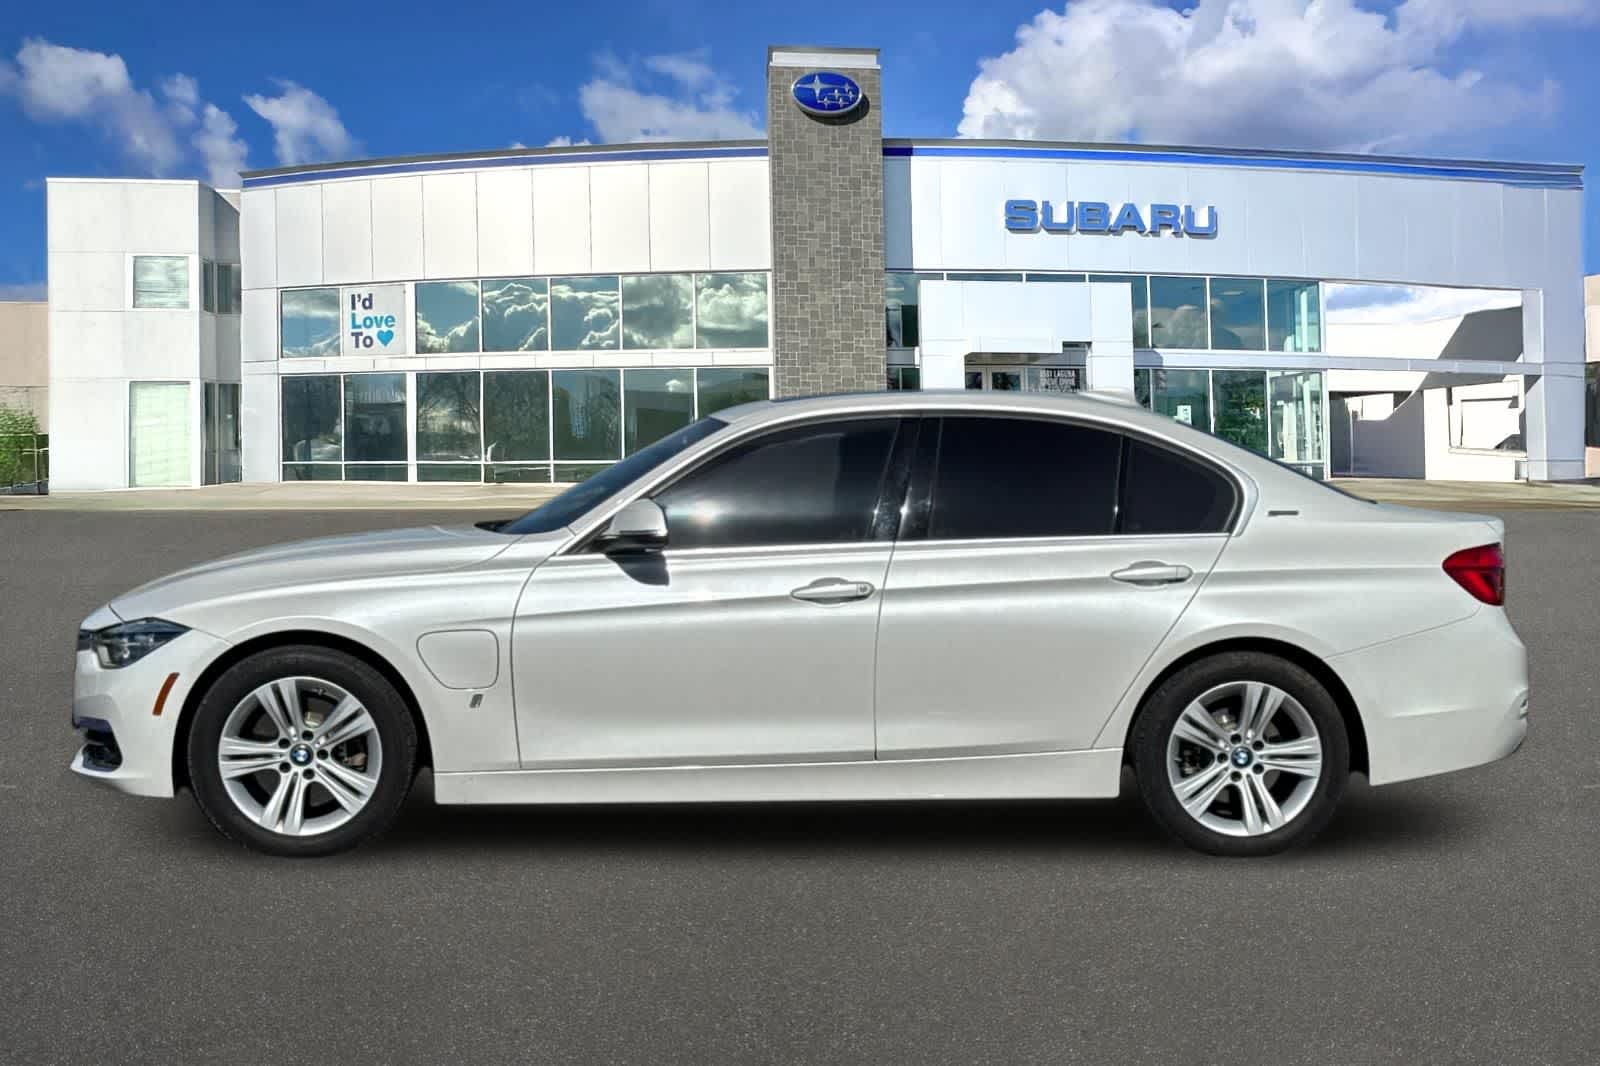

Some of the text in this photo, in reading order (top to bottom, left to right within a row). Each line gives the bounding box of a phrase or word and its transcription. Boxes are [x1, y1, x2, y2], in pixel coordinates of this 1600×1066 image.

[1005, 200, 1217, 239] SUBARU
[351, 312, 396, 329] Love
[351, 331, 374, 348] To
